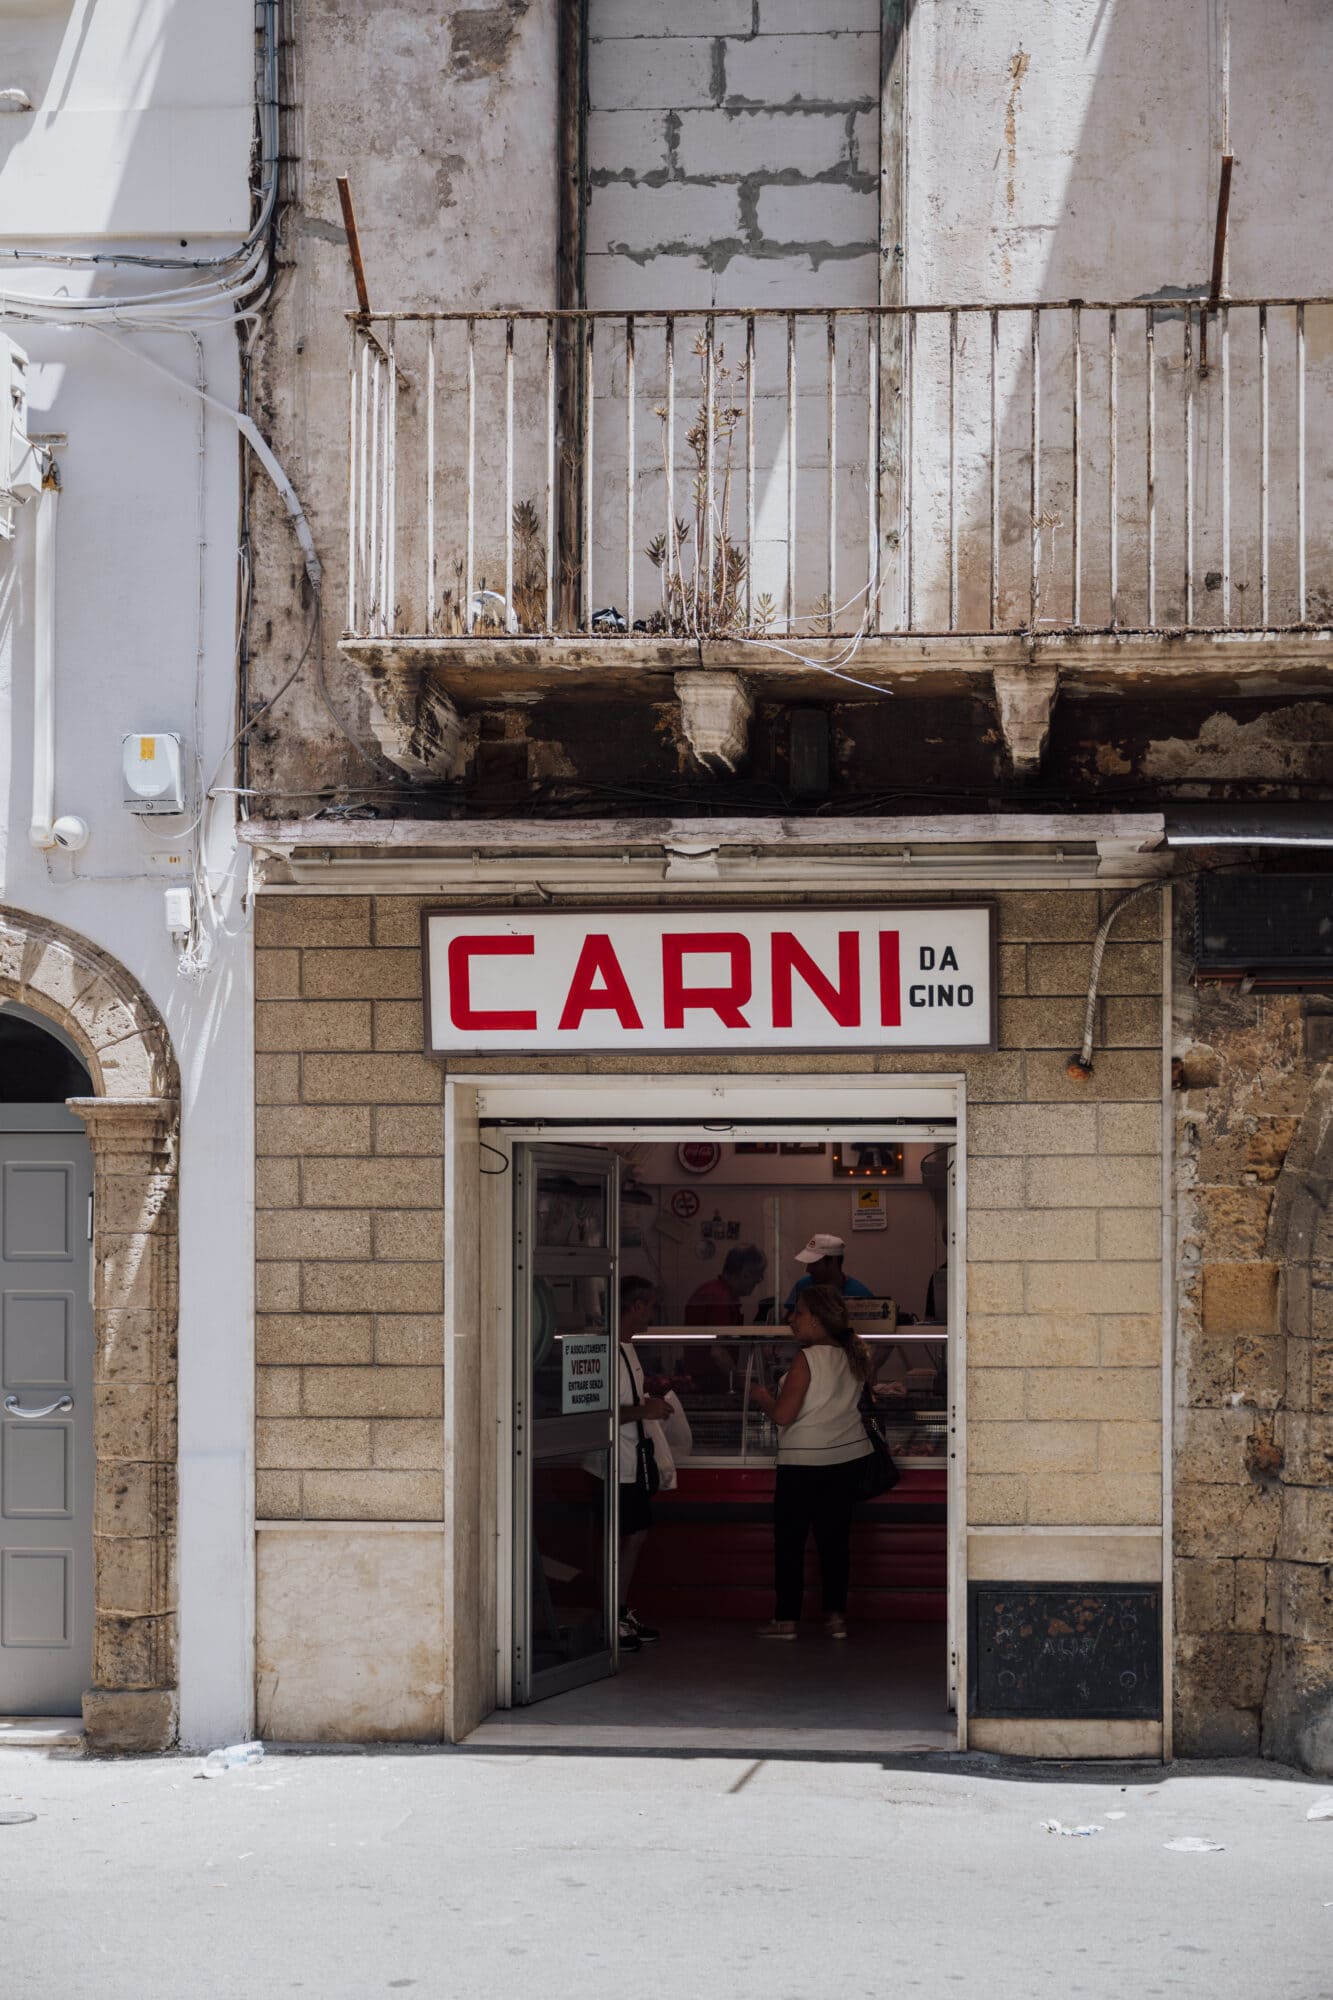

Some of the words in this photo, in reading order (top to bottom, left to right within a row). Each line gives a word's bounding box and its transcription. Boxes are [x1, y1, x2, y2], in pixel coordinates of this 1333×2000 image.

[920, 946, 958, 970] DA
[448, 931, 900, 1030] CARNI
[910, 985, 973, 1007] GINO
[570, 1344, 606, 1354] ASSOLUTAMENTE
[571, 1359, 600, 1375] VIETATO
[568, 1380, 588, 1391] ENTRARE
[589, 1379, 603, 1389] SENZA
